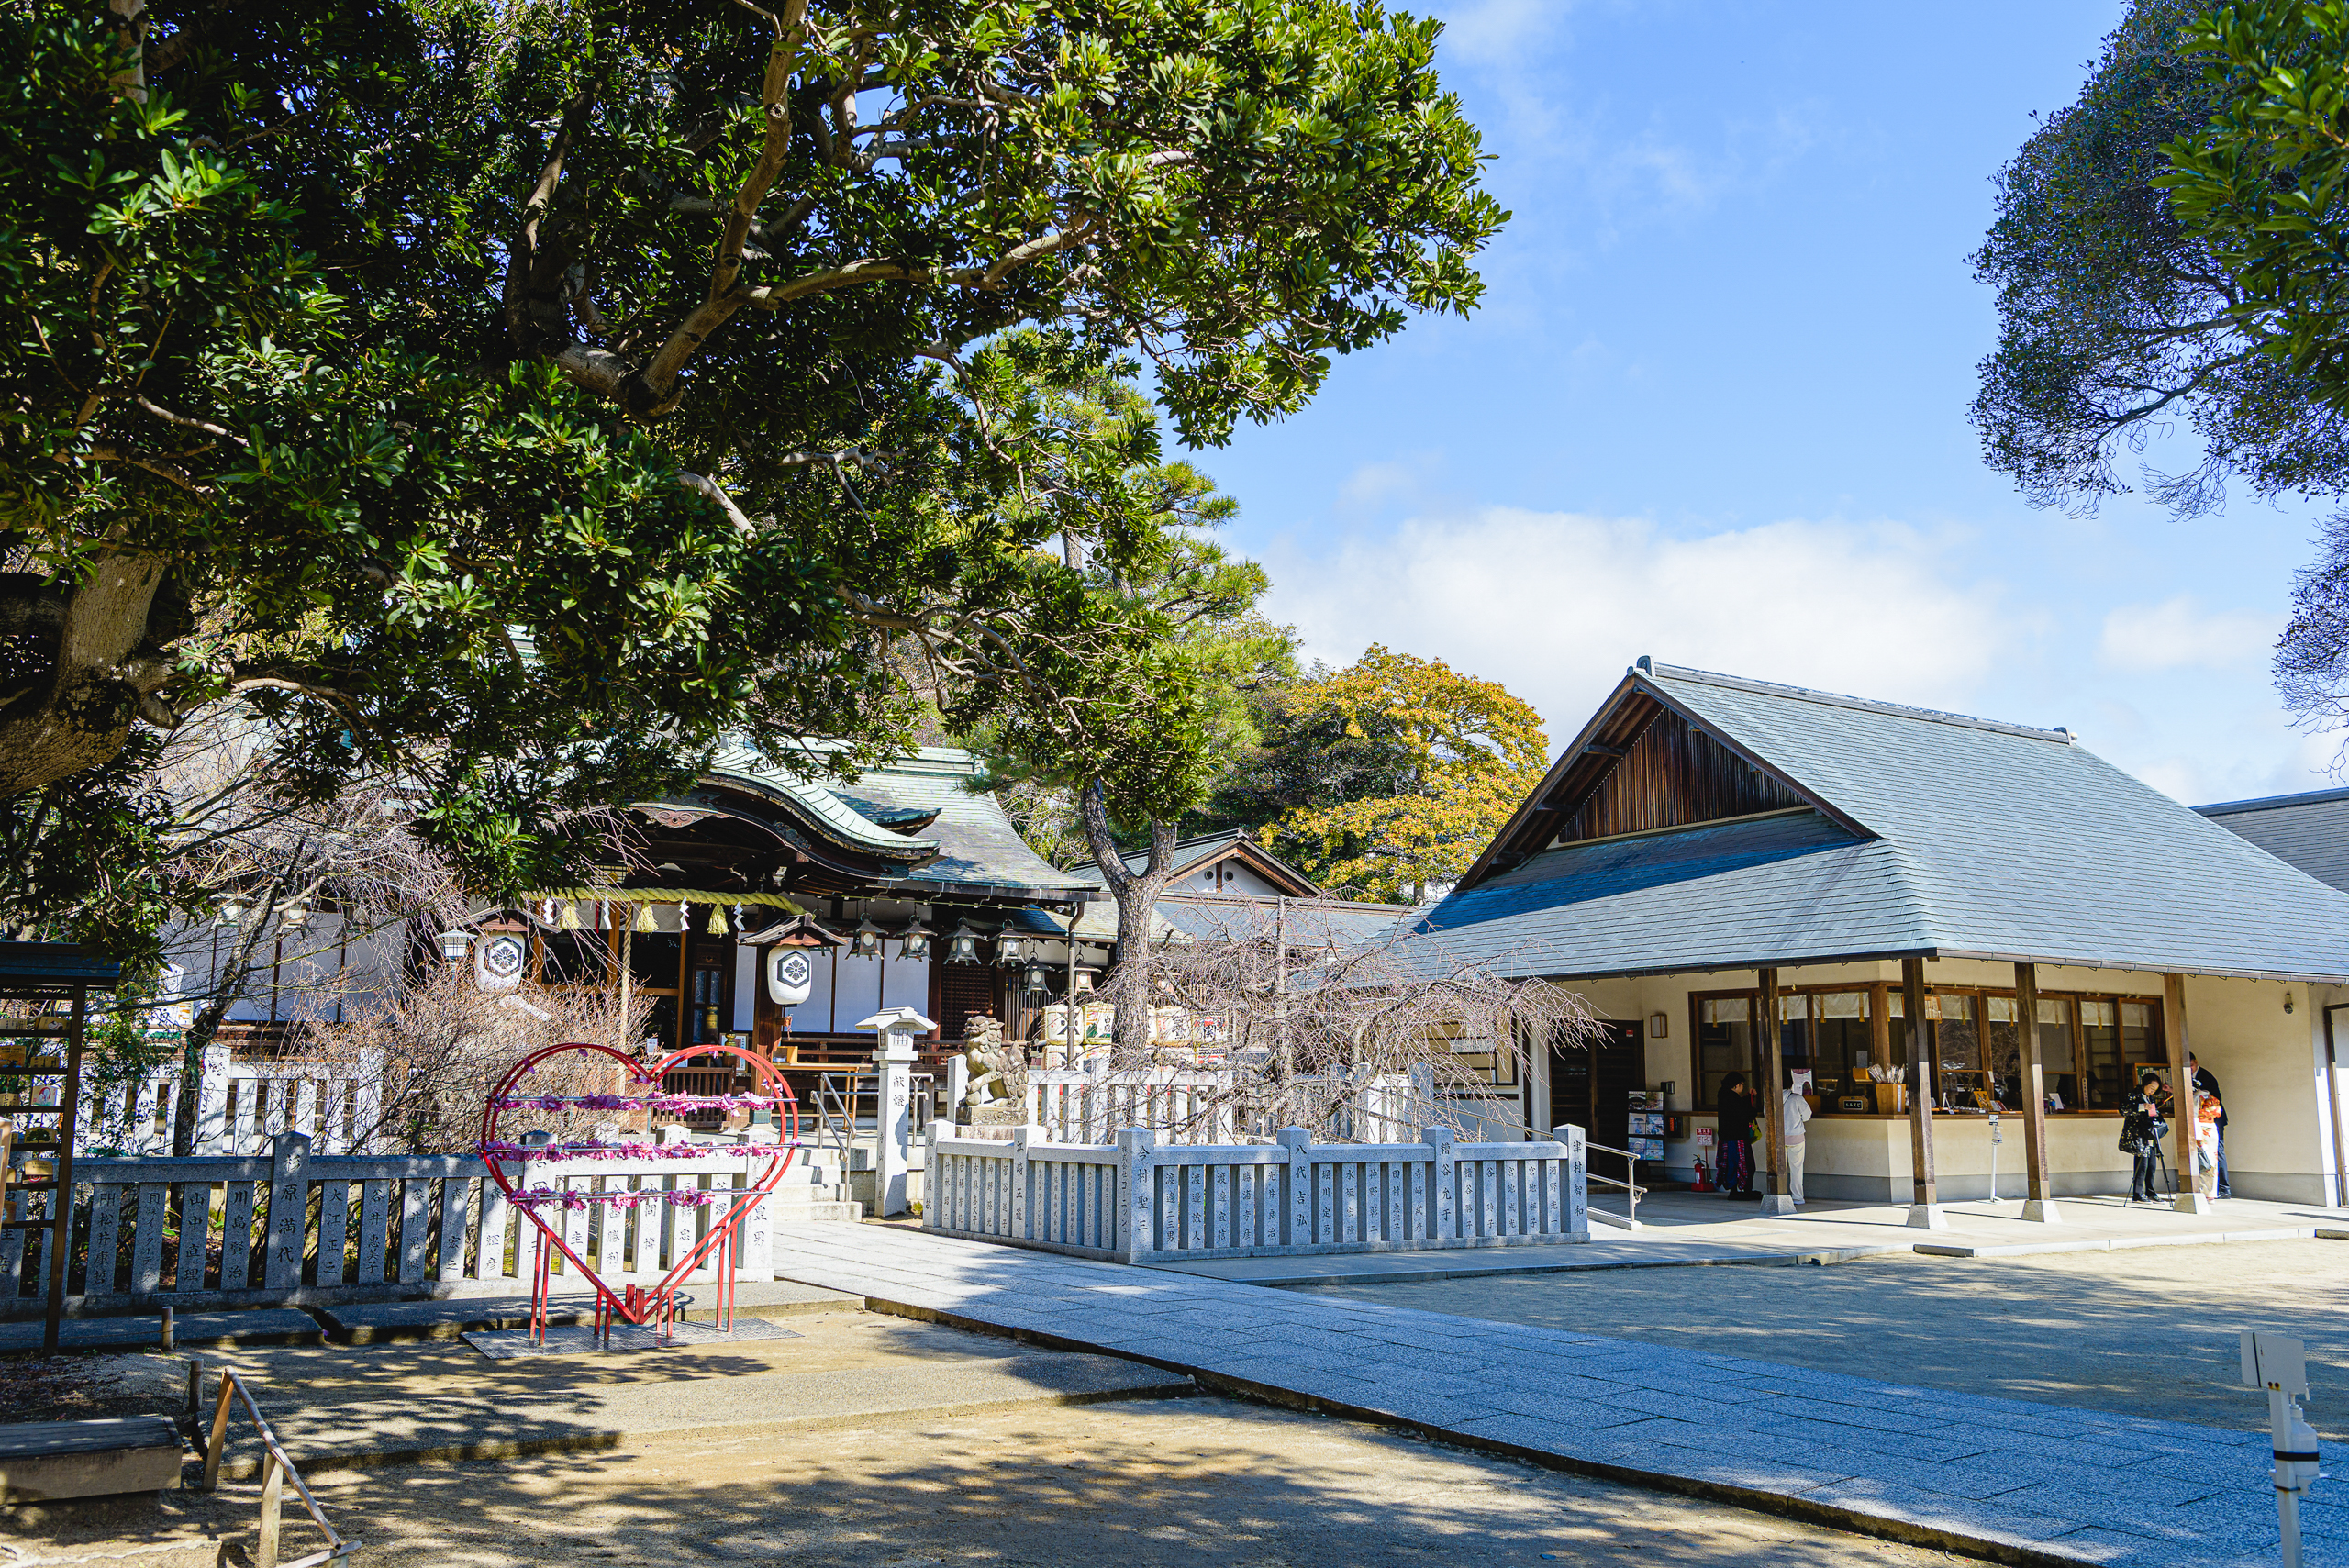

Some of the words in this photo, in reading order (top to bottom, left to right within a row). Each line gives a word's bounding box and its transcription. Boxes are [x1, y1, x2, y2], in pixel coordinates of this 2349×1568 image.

[277, 1153, 301, 1263] 杉原満代
[1138, 1145, 1150, 1231] 今村聖三
[1267, 1171, 1276, 1239] 光井良治
[1295, 1144, 1308, 1227] 八代吉弘
[1548, 1166, 1558, 1223] 河野光一
[1572, 1140, 1585, 1217] 津村智和
[184, 1192, 205, 1281] 山中直理
[228, 1190, 248, 1279] 川島賢治
[323, 1188, 343, 1274] 大江正之
[445, 1186, 464, 1271] 森宏之
